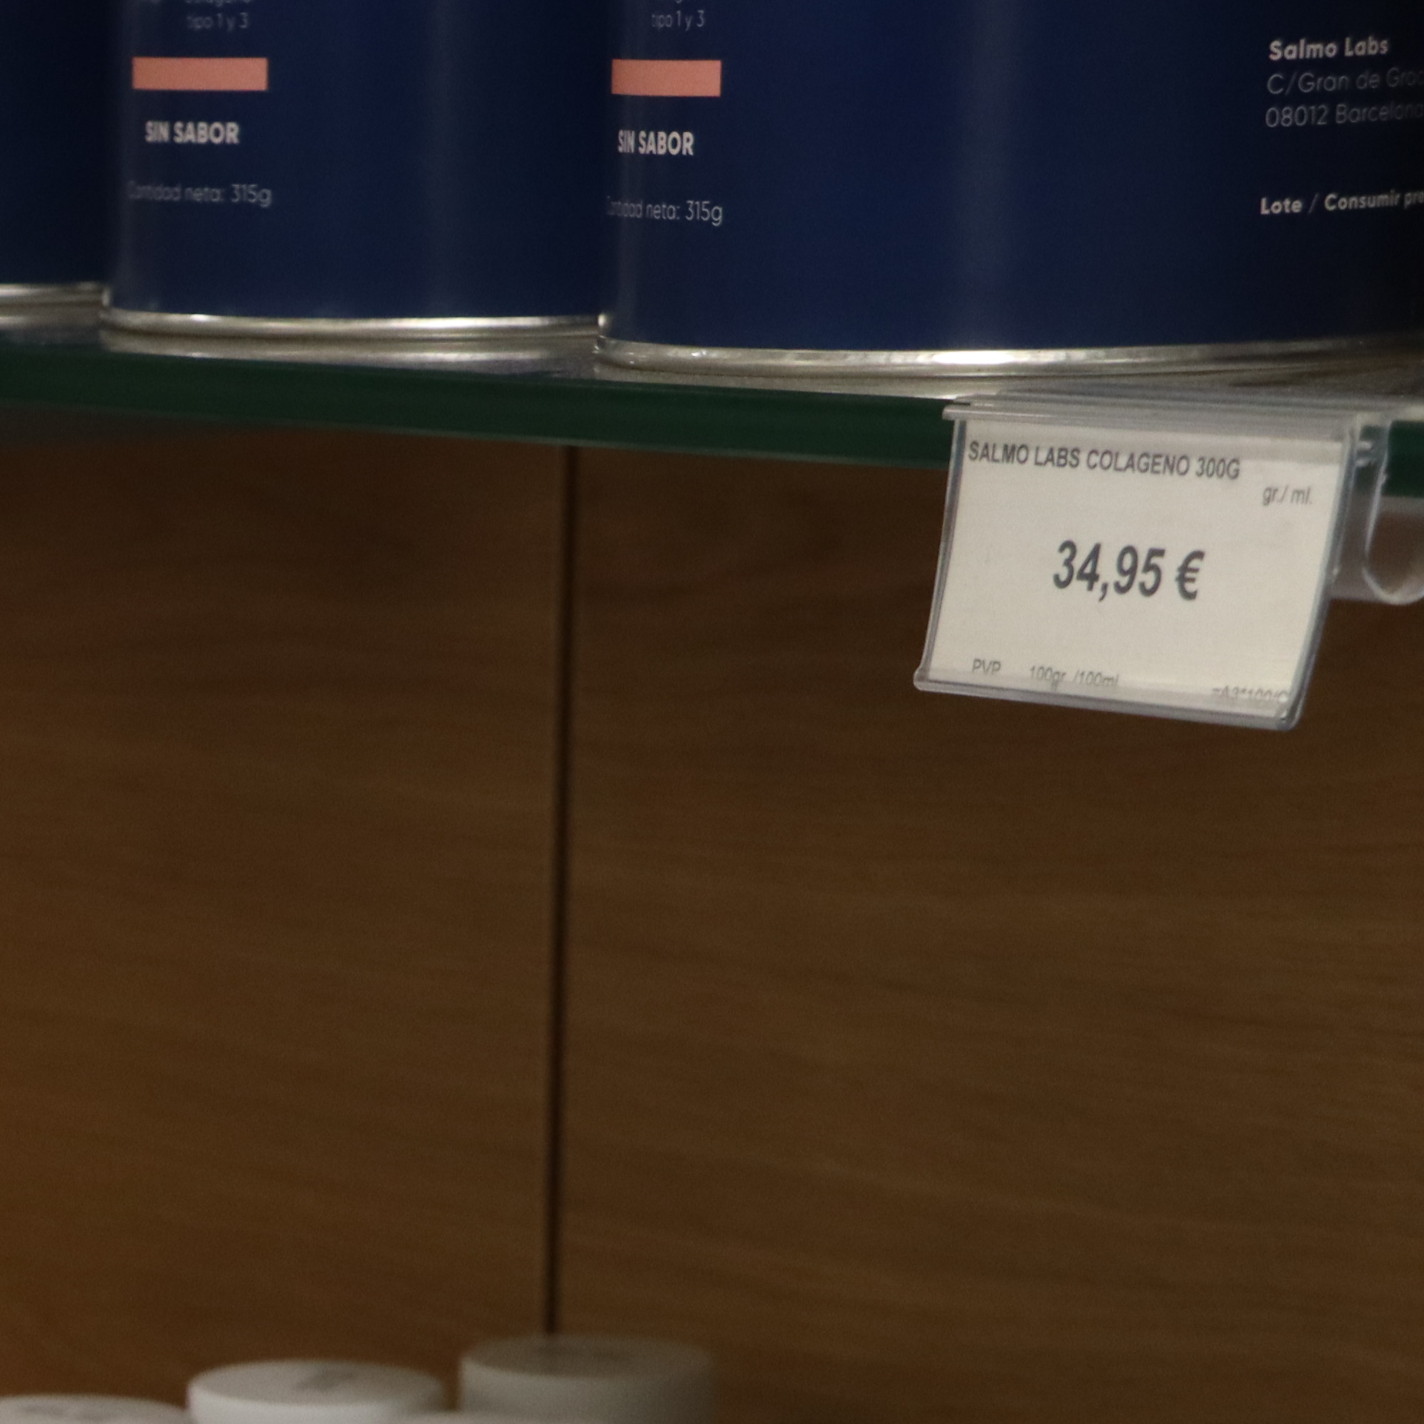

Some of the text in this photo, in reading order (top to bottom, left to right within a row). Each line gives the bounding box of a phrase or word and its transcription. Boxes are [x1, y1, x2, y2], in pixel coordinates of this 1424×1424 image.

[1269, 35, 1389, 61] Salmo Labs
[1267, 71, 1350, 96] C/Gran
[1265, 104, 1328, 128] 08012
[145, 120, 240, 144] SIN SABOR
[618, 130, 695, 156] SIN SABOR
[231, 183, 272, 208] 315g
[1260, 197, 1303, 216] Lote
[685, 200, 723, 227] 315g
[967, 440, 1241, 480] SALMO LABS COLAGENO 300G
[1053, 538, 1206, 602] 34,95 €
[972, 658, 1002, 676] PVP
